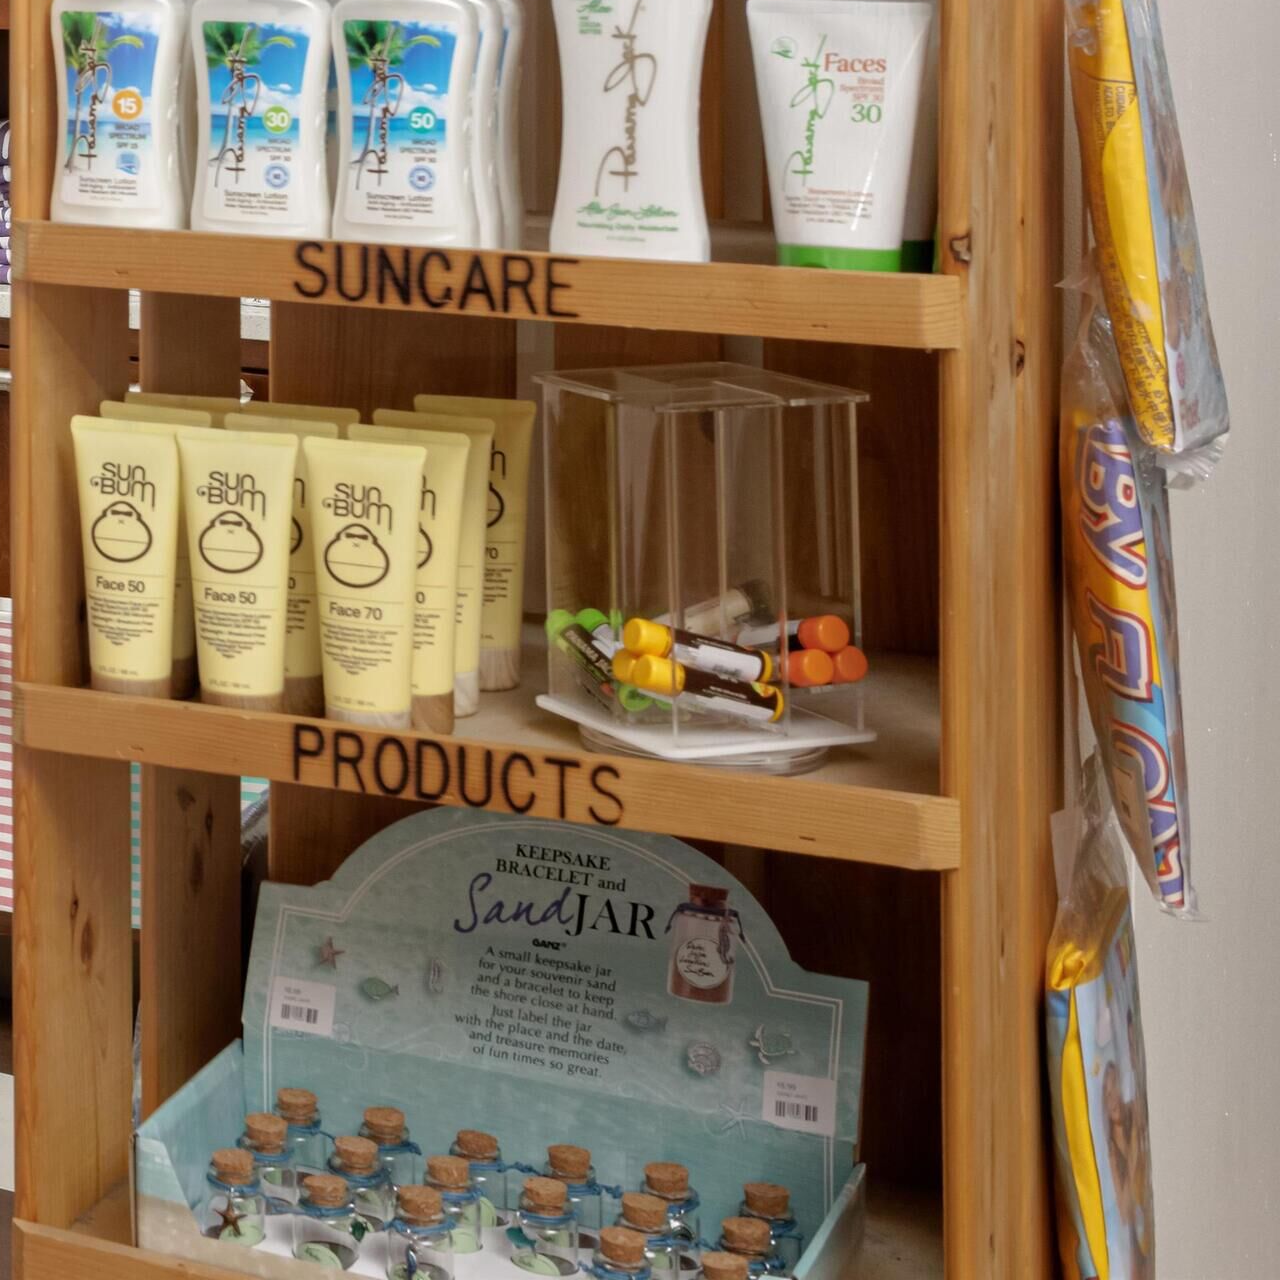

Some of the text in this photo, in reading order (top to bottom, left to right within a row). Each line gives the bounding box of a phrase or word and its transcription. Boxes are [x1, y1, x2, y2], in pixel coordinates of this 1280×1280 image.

[822, 51, 887, 75] Faces
[117, 97, 138, 115] 15
[266, 111, 289, 129] 30
[410, 112, 434, 130] 50
[850, 103, 883, 123] 30
[293, 241, 580, 317] SUNCARE
[96, 576, 146, 594] Face 50
[204, 587, 257, 606] Face 50
[328, 602, 383, 621] Face 70
[292, 722, 625, 827] PRODUCTS
[516, 843, 611, 871] KEEPSAKE
[496, 858, 626, 893] BRACELET and
[478, 957, 617, 992] for your souvenir sand
[486, 945, 612, 978] A small keepsake jar
[471, 985, 617, 1021] the shore close at hand.
[477, 974, 614, 1006] and a bracelet to keep
[492, 1004, 592, 1033] Just label the jar
[454, 1014, 627, 1055] with the place and the date,
[469, 1029, 610, 1065] and treasure memories
[473, 1045, 602, 1078] of fun times so great.
